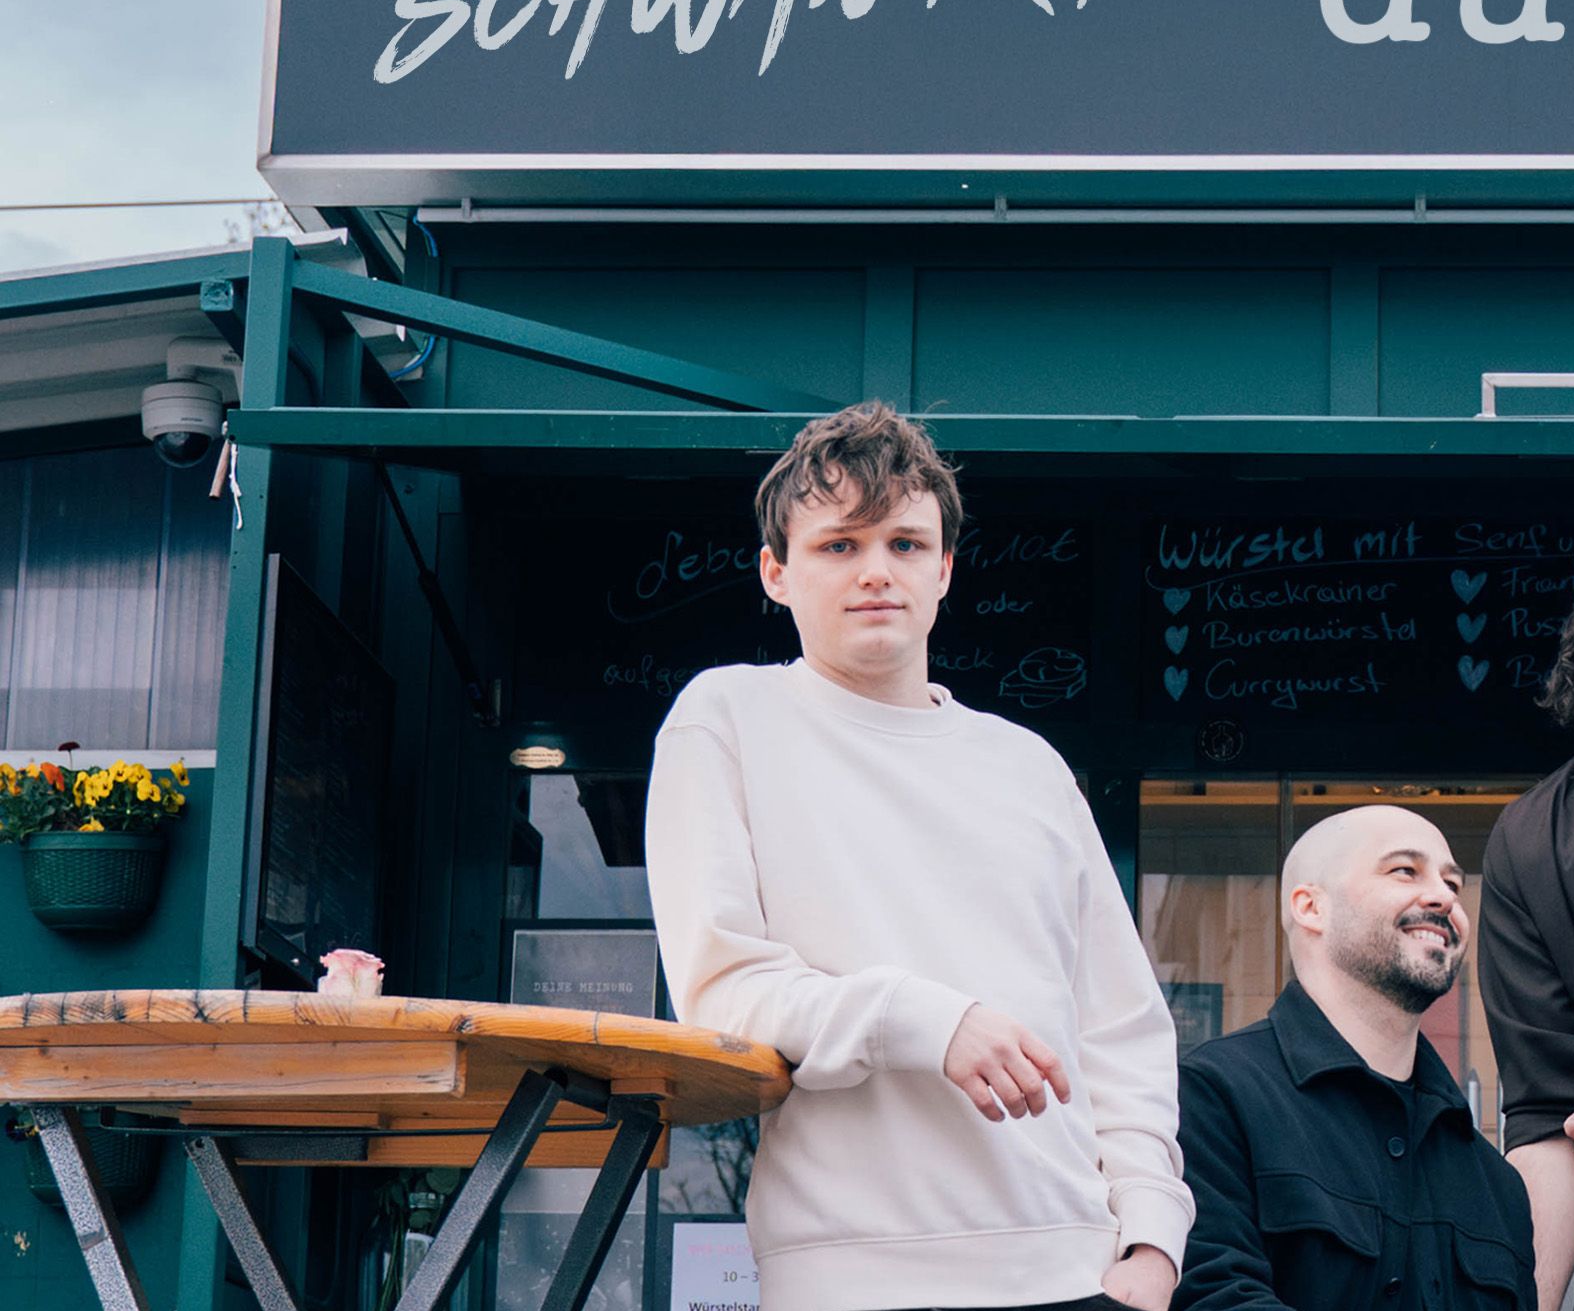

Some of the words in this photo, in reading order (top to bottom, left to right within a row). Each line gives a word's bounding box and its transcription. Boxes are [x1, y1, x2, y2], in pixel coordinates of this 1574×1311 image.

[1159, 524, 1325, 570] Würstel
[1353, 520, 1424, 560] mit
[1455, 522, 1547, 558] Senf
[976, 591, 1034, 615] oder
[1206, 579, 1401, 612] Käsekrainer
[1201, 611, 1417, 649] Burenwürstel
[1205, 658, 1391, 710] Currywurst
[723, 1271, 738, 1283] 10
